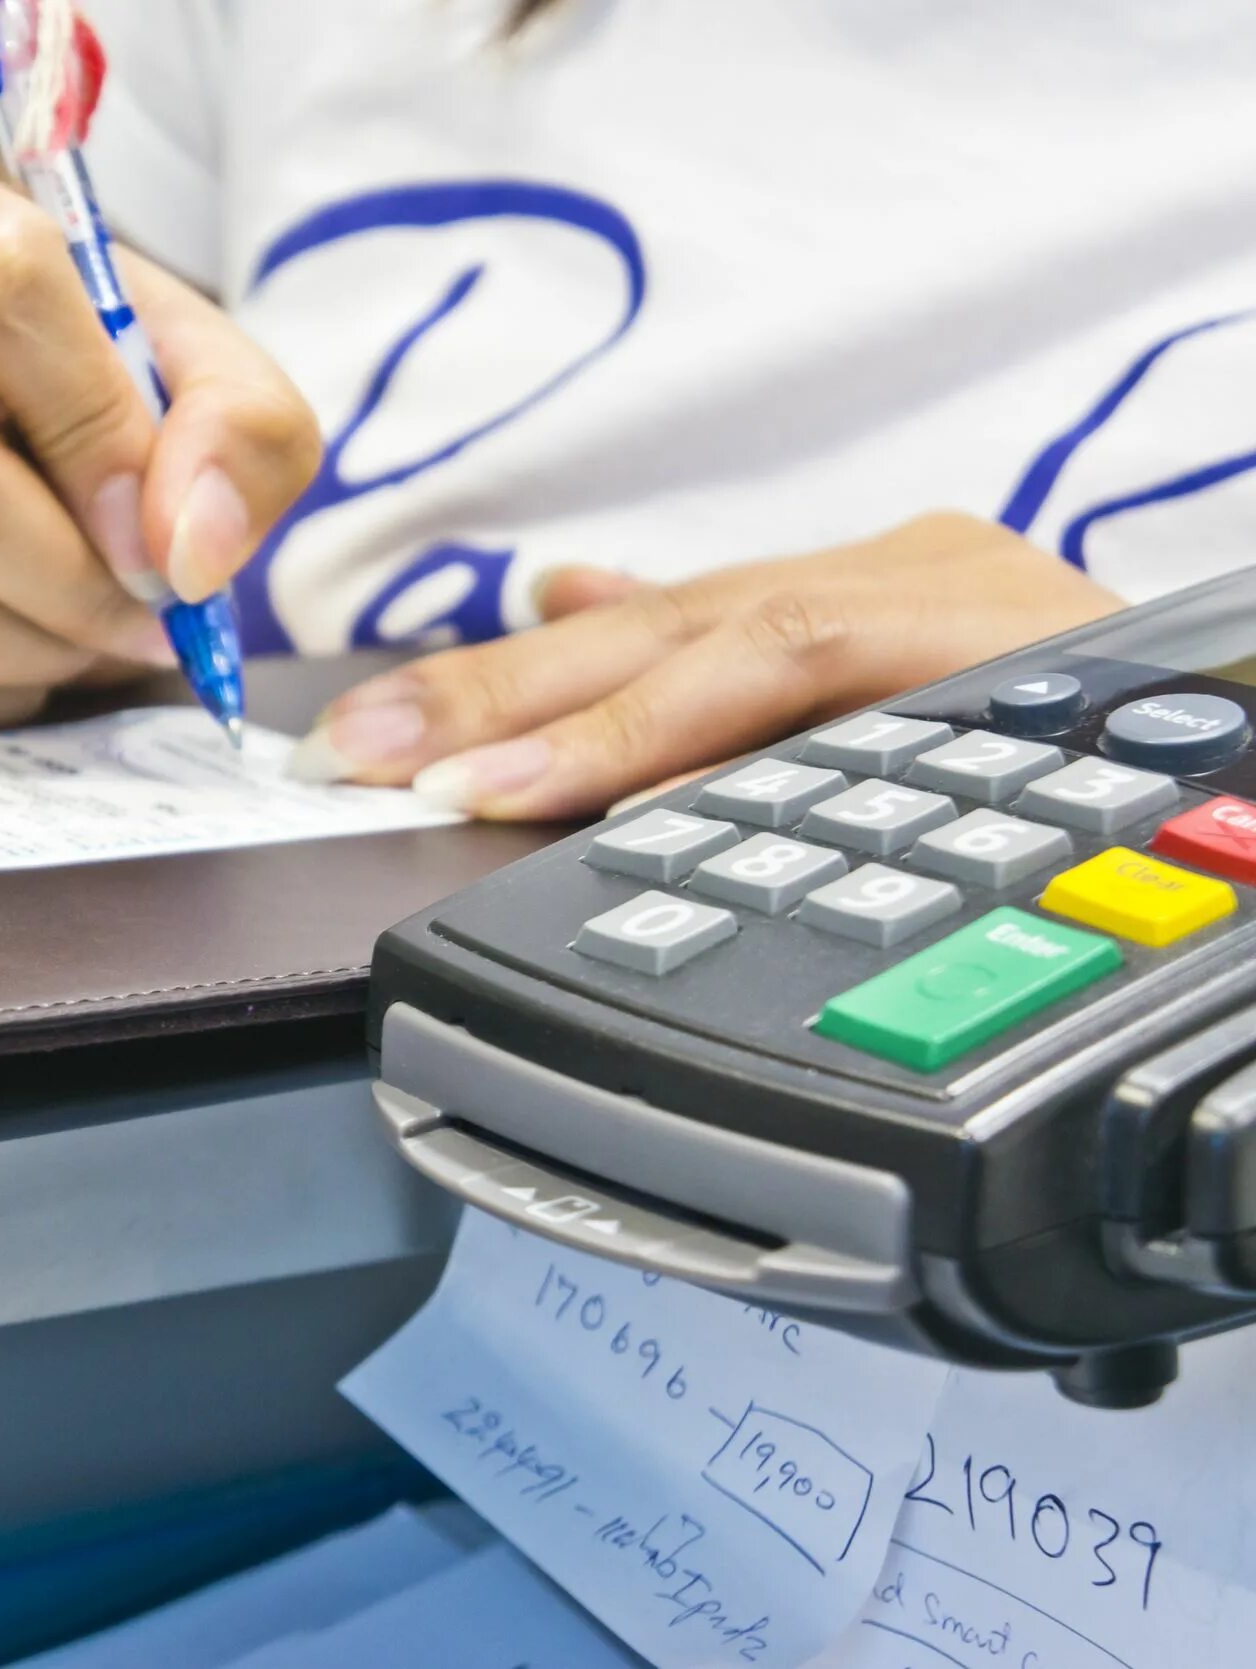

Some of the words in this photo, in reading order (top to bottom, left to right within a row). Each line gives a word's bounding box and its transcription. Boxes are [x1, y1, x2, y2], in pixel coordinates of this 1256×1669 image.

[1131, 701, 1222, 731] Select
[848, 721, 905, 746] 1
[939, 741, 1019, 772] 2
[735, 769, 799, 797] 4
[1052, 767, 1137, 800] 3
[836, 787, 920, 822] 5
[623, 817, 705, 847] 7
[951, 821, 1031, 854] 6
[730, 843, 808, 878] 8
[840, 874, 918, 908] 9
[619, 903, 694, 938] 0
[983, 922, 1071, 959] Enter
[904, 1432, 1163, 1611] 219039
